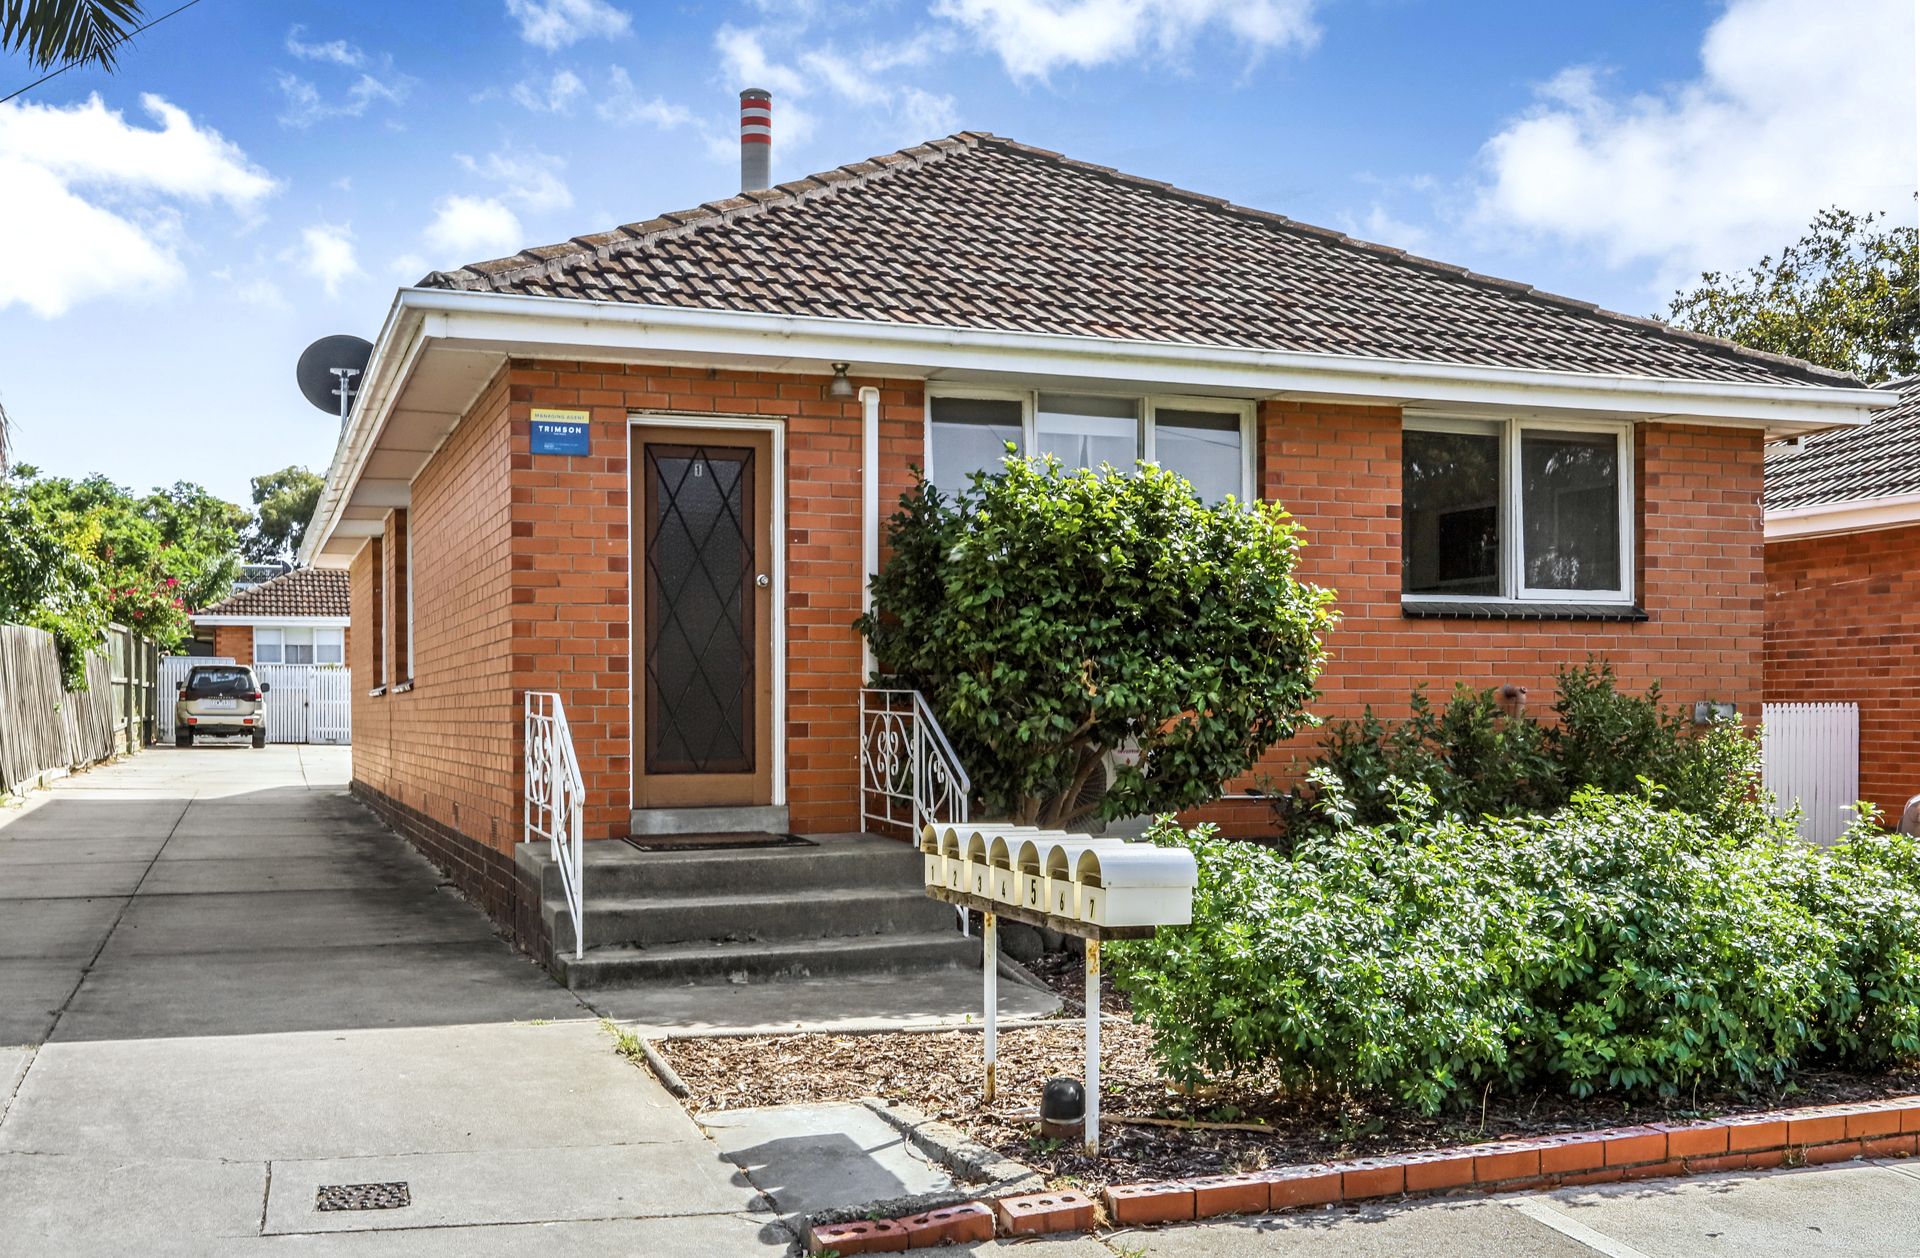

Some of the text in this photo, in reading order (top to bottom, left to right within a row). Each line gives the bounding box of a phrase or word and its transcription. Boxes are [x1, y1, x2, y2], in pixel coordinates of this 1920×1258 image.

[538, 425, 582, 434] TRIMSON
[930, 865, 935, 881] 1
[952, 870, 958, 887] 2
[977, 875, 982, 893] 3
[1001, 881, 1006, 898] 4
[1030, 879, 1037, 905] 5
[1059, 892, 1065, 911] 6
[1089, 898, 1095, 918] 7
